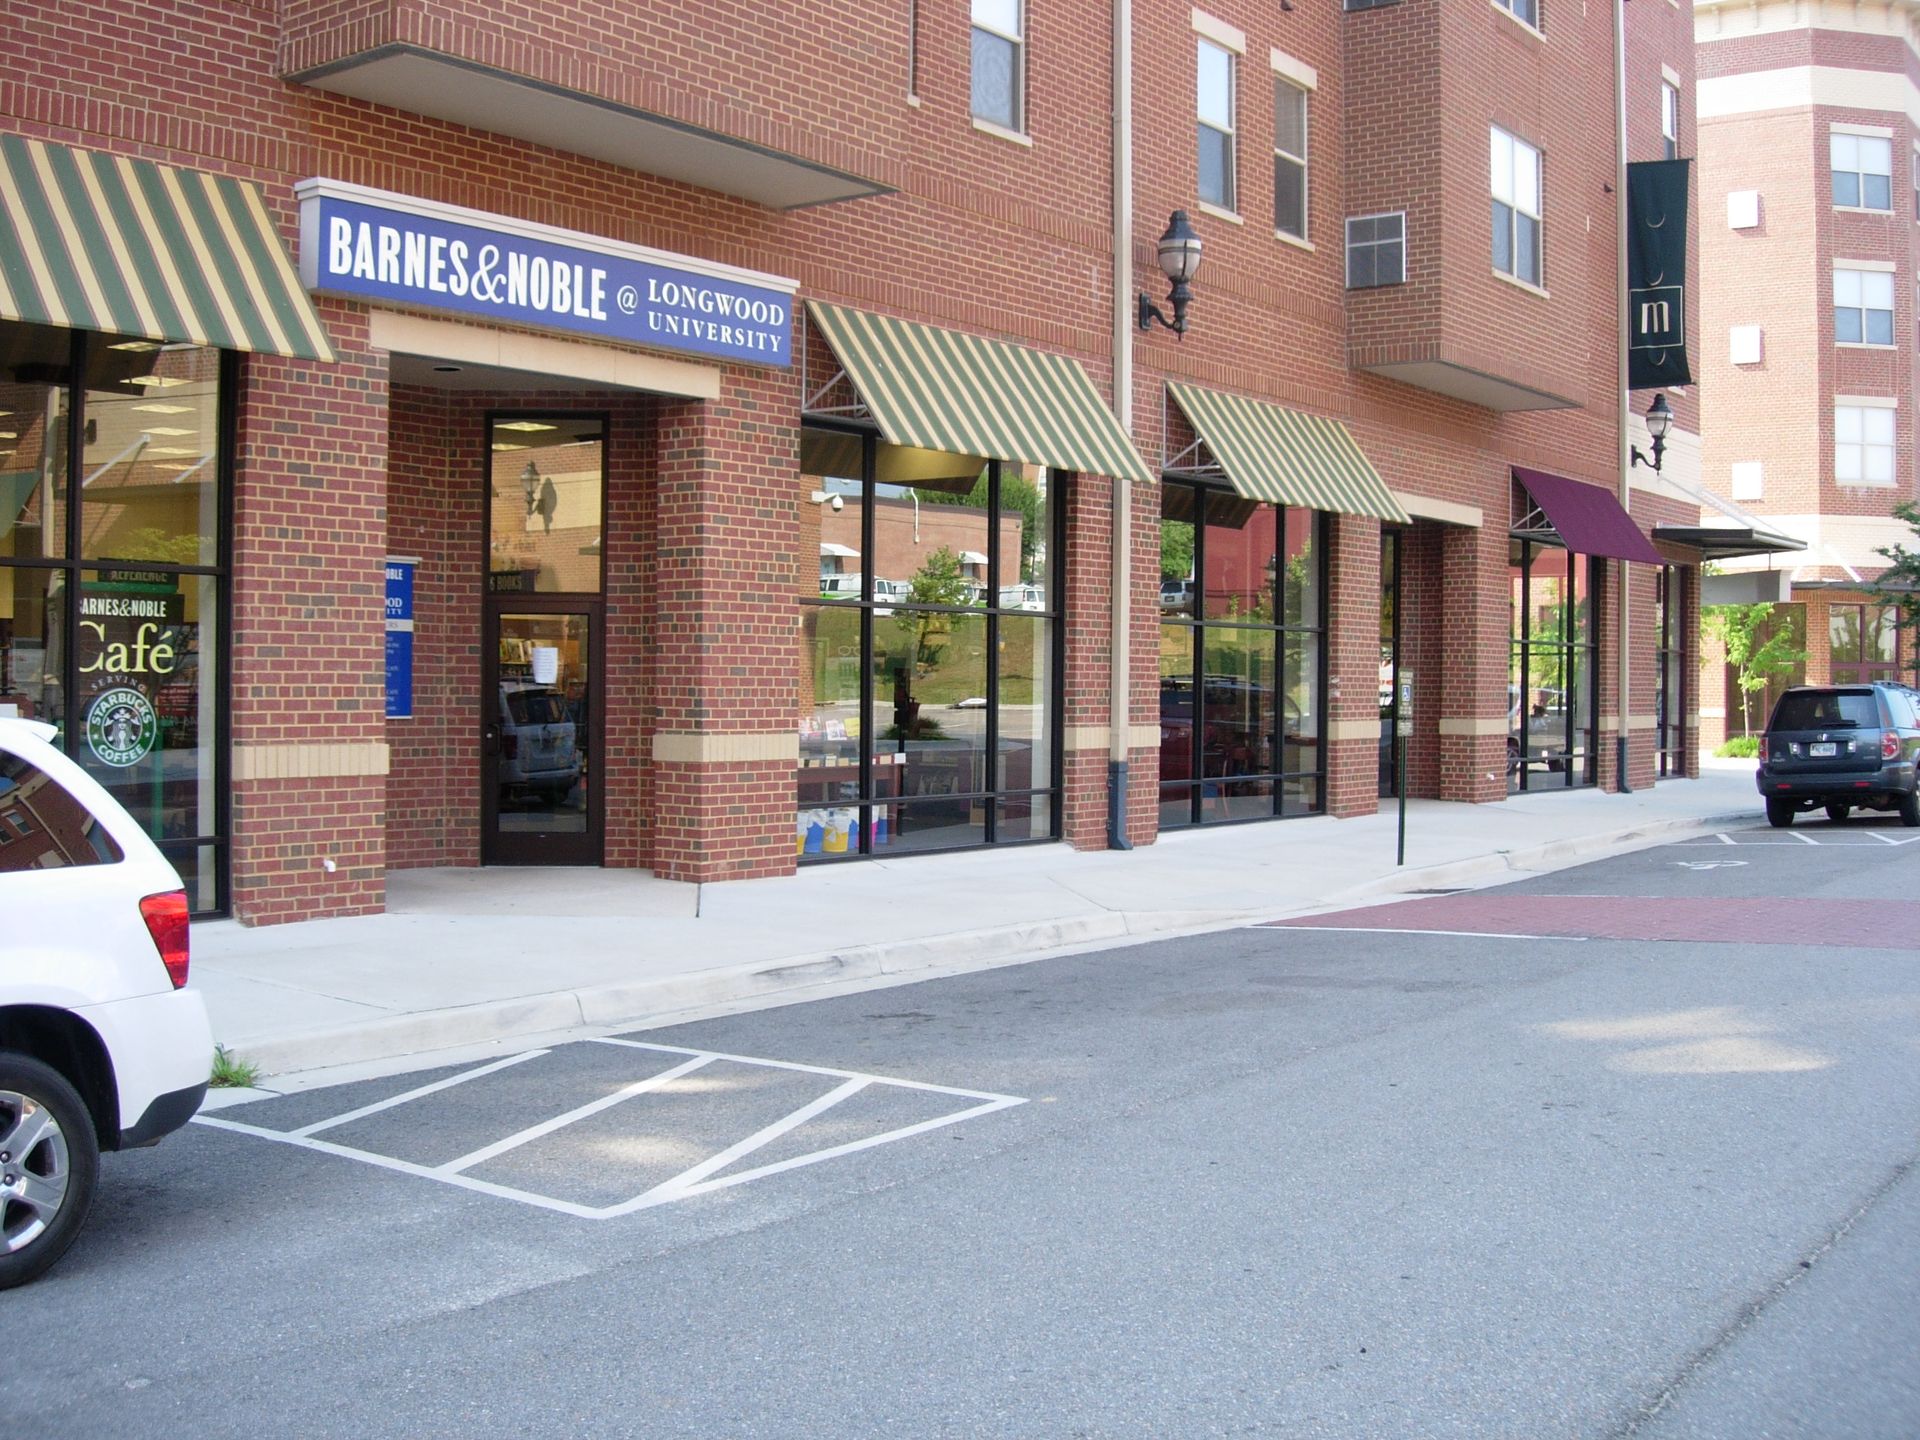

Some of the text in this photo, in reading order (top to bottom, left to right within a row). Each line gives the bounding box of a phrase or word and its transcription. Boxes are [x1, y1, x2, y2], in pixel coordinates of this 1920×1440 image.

[329, 217, 638, 321] BARNES&NOBLE @
[648, 278, 784, 327] LONGWOOD
[648, 311, 783, 353] UNIVERSITY
[80, 597, 167, 618] ARNES&NOBLE
[79, 620, 174, 675] Café
[91, 675, 147, 694] SERVING
[91, 692, 153, 726] STARBUCKS
[97, 743, 145, 763] COFFEE
